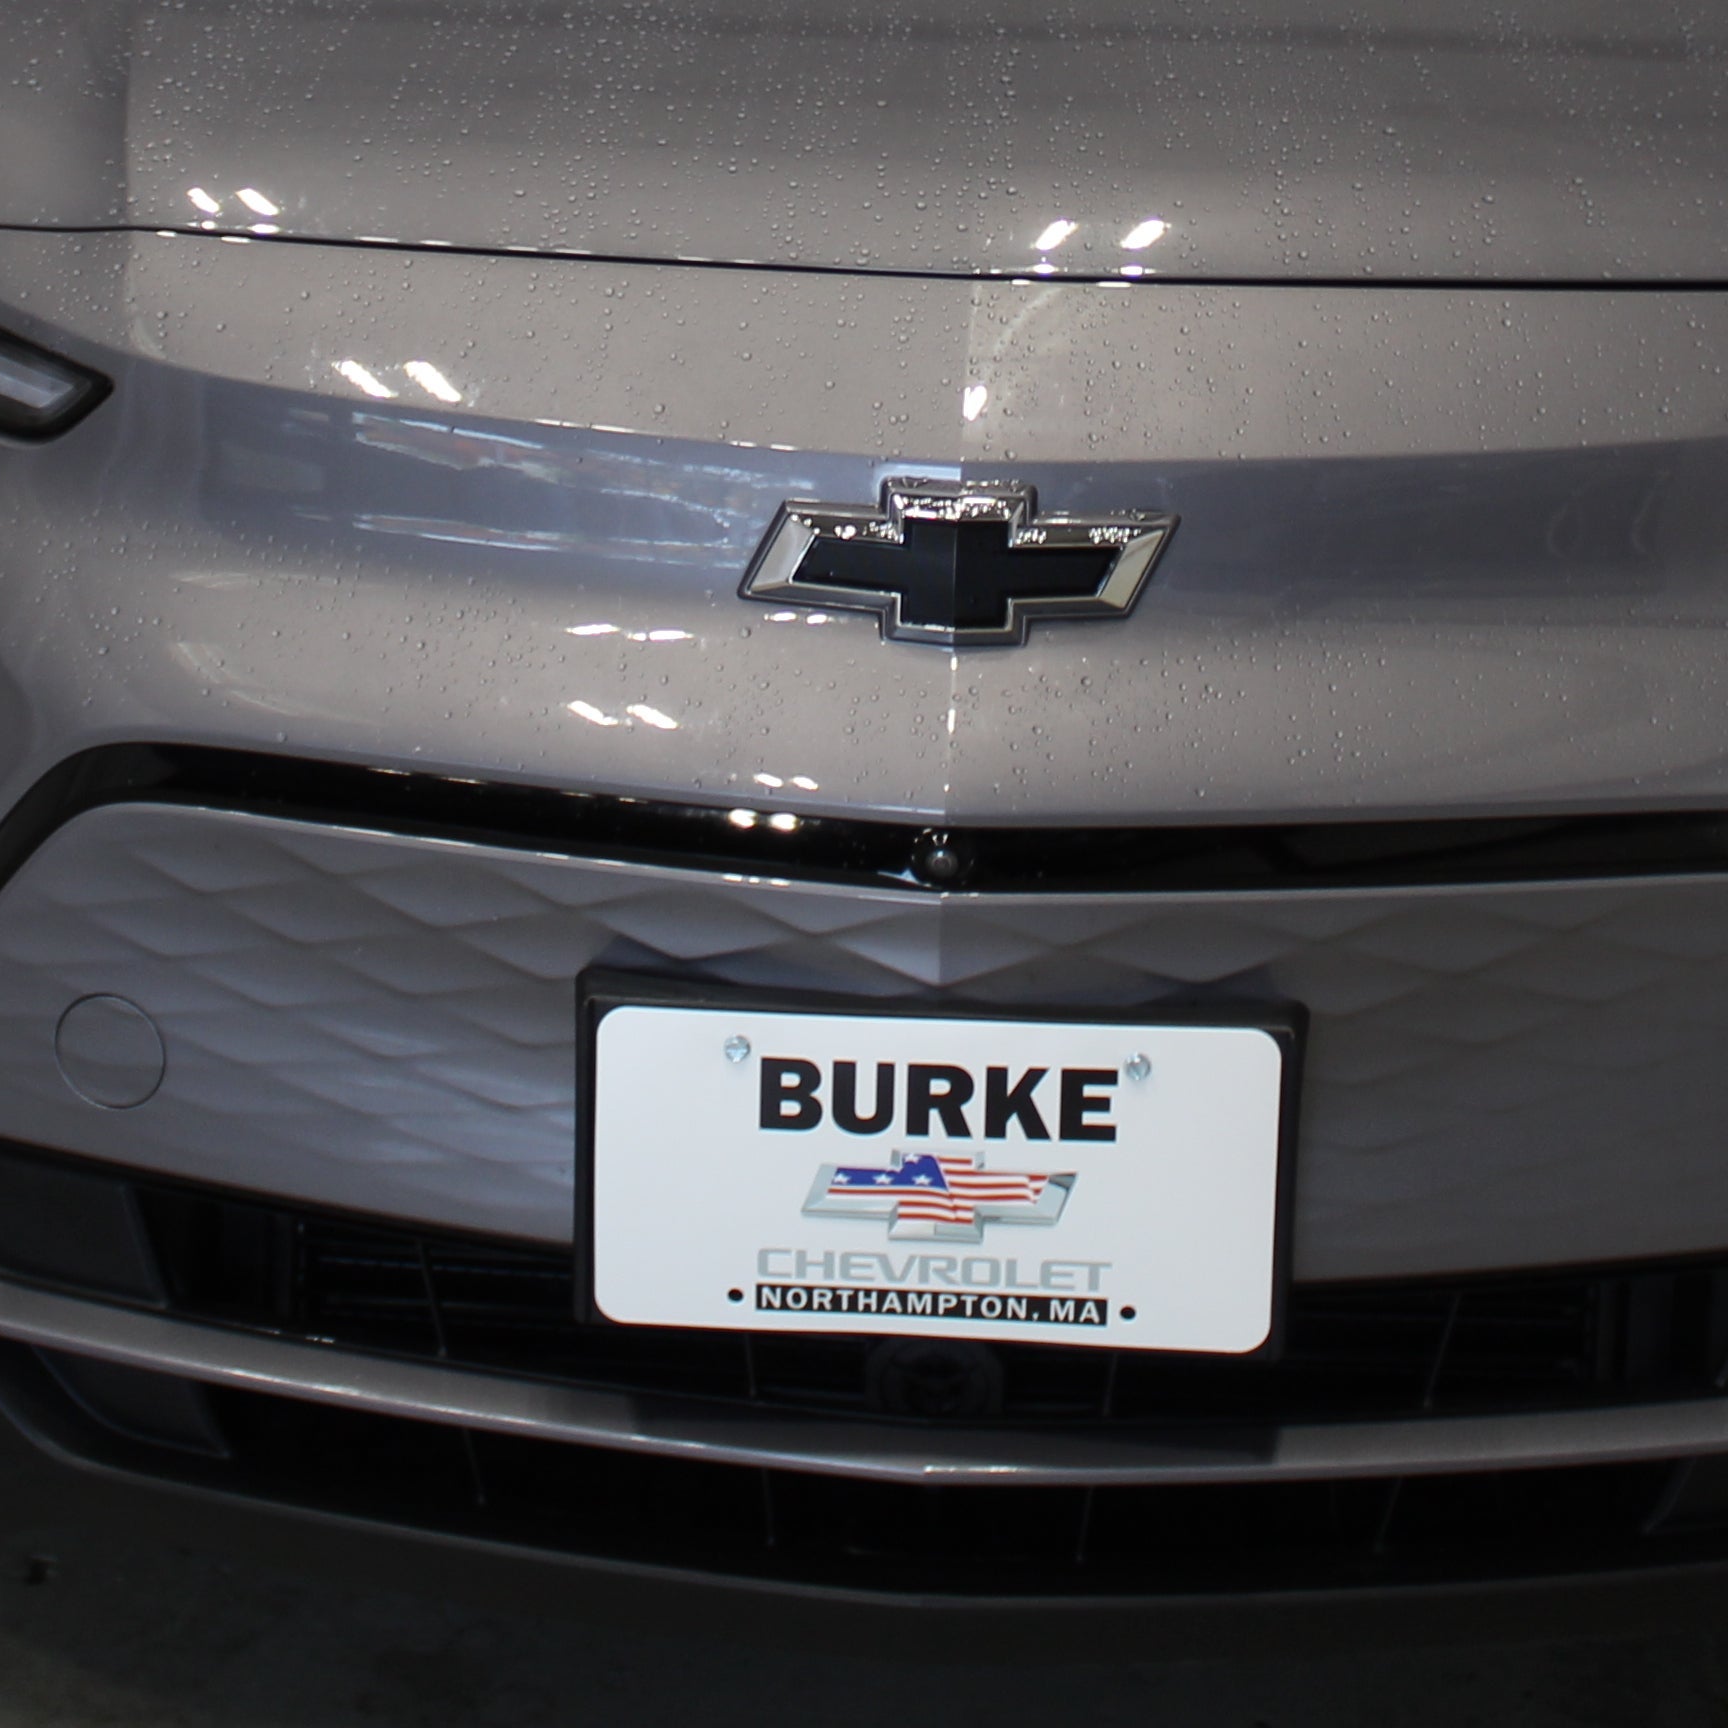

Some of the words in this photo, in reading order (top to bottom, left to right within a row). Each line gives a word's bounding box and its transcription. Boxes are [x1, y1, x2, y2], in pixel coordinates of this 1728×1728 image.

[758, 1057, 1119, 1141] BURKE
[757, 1249, 1112, 1292] CHEVROLET
[760, 1286, 1040, 1321] NORTHAMPTON,
[1049, 1299, 1101, 1323] MA
